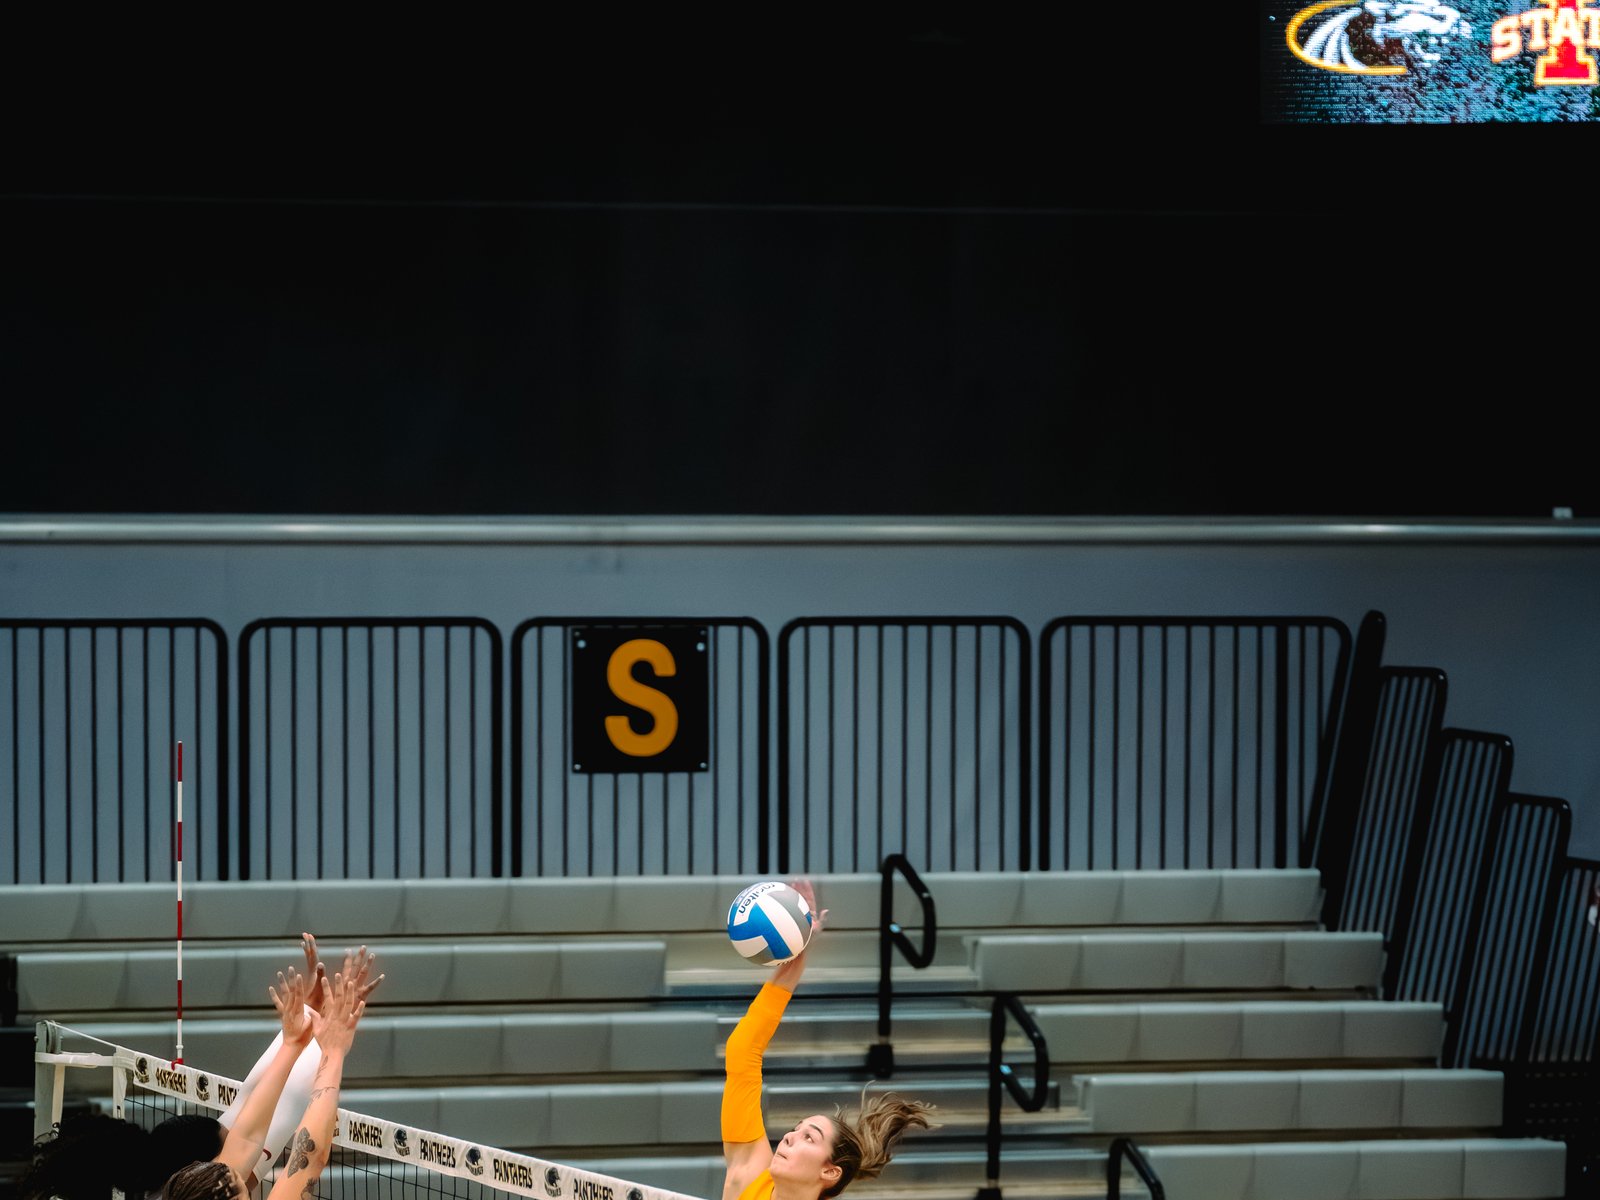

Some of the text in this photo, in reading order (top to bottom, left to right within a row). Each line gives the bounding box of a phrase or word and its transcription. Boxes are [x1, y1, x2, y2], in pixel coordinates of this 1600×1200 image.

[605, 638, 679, 757] S
[420, 1138, 456, 1169] PANTHERS
[493, 1158, 533, 1190] PANTHERS
